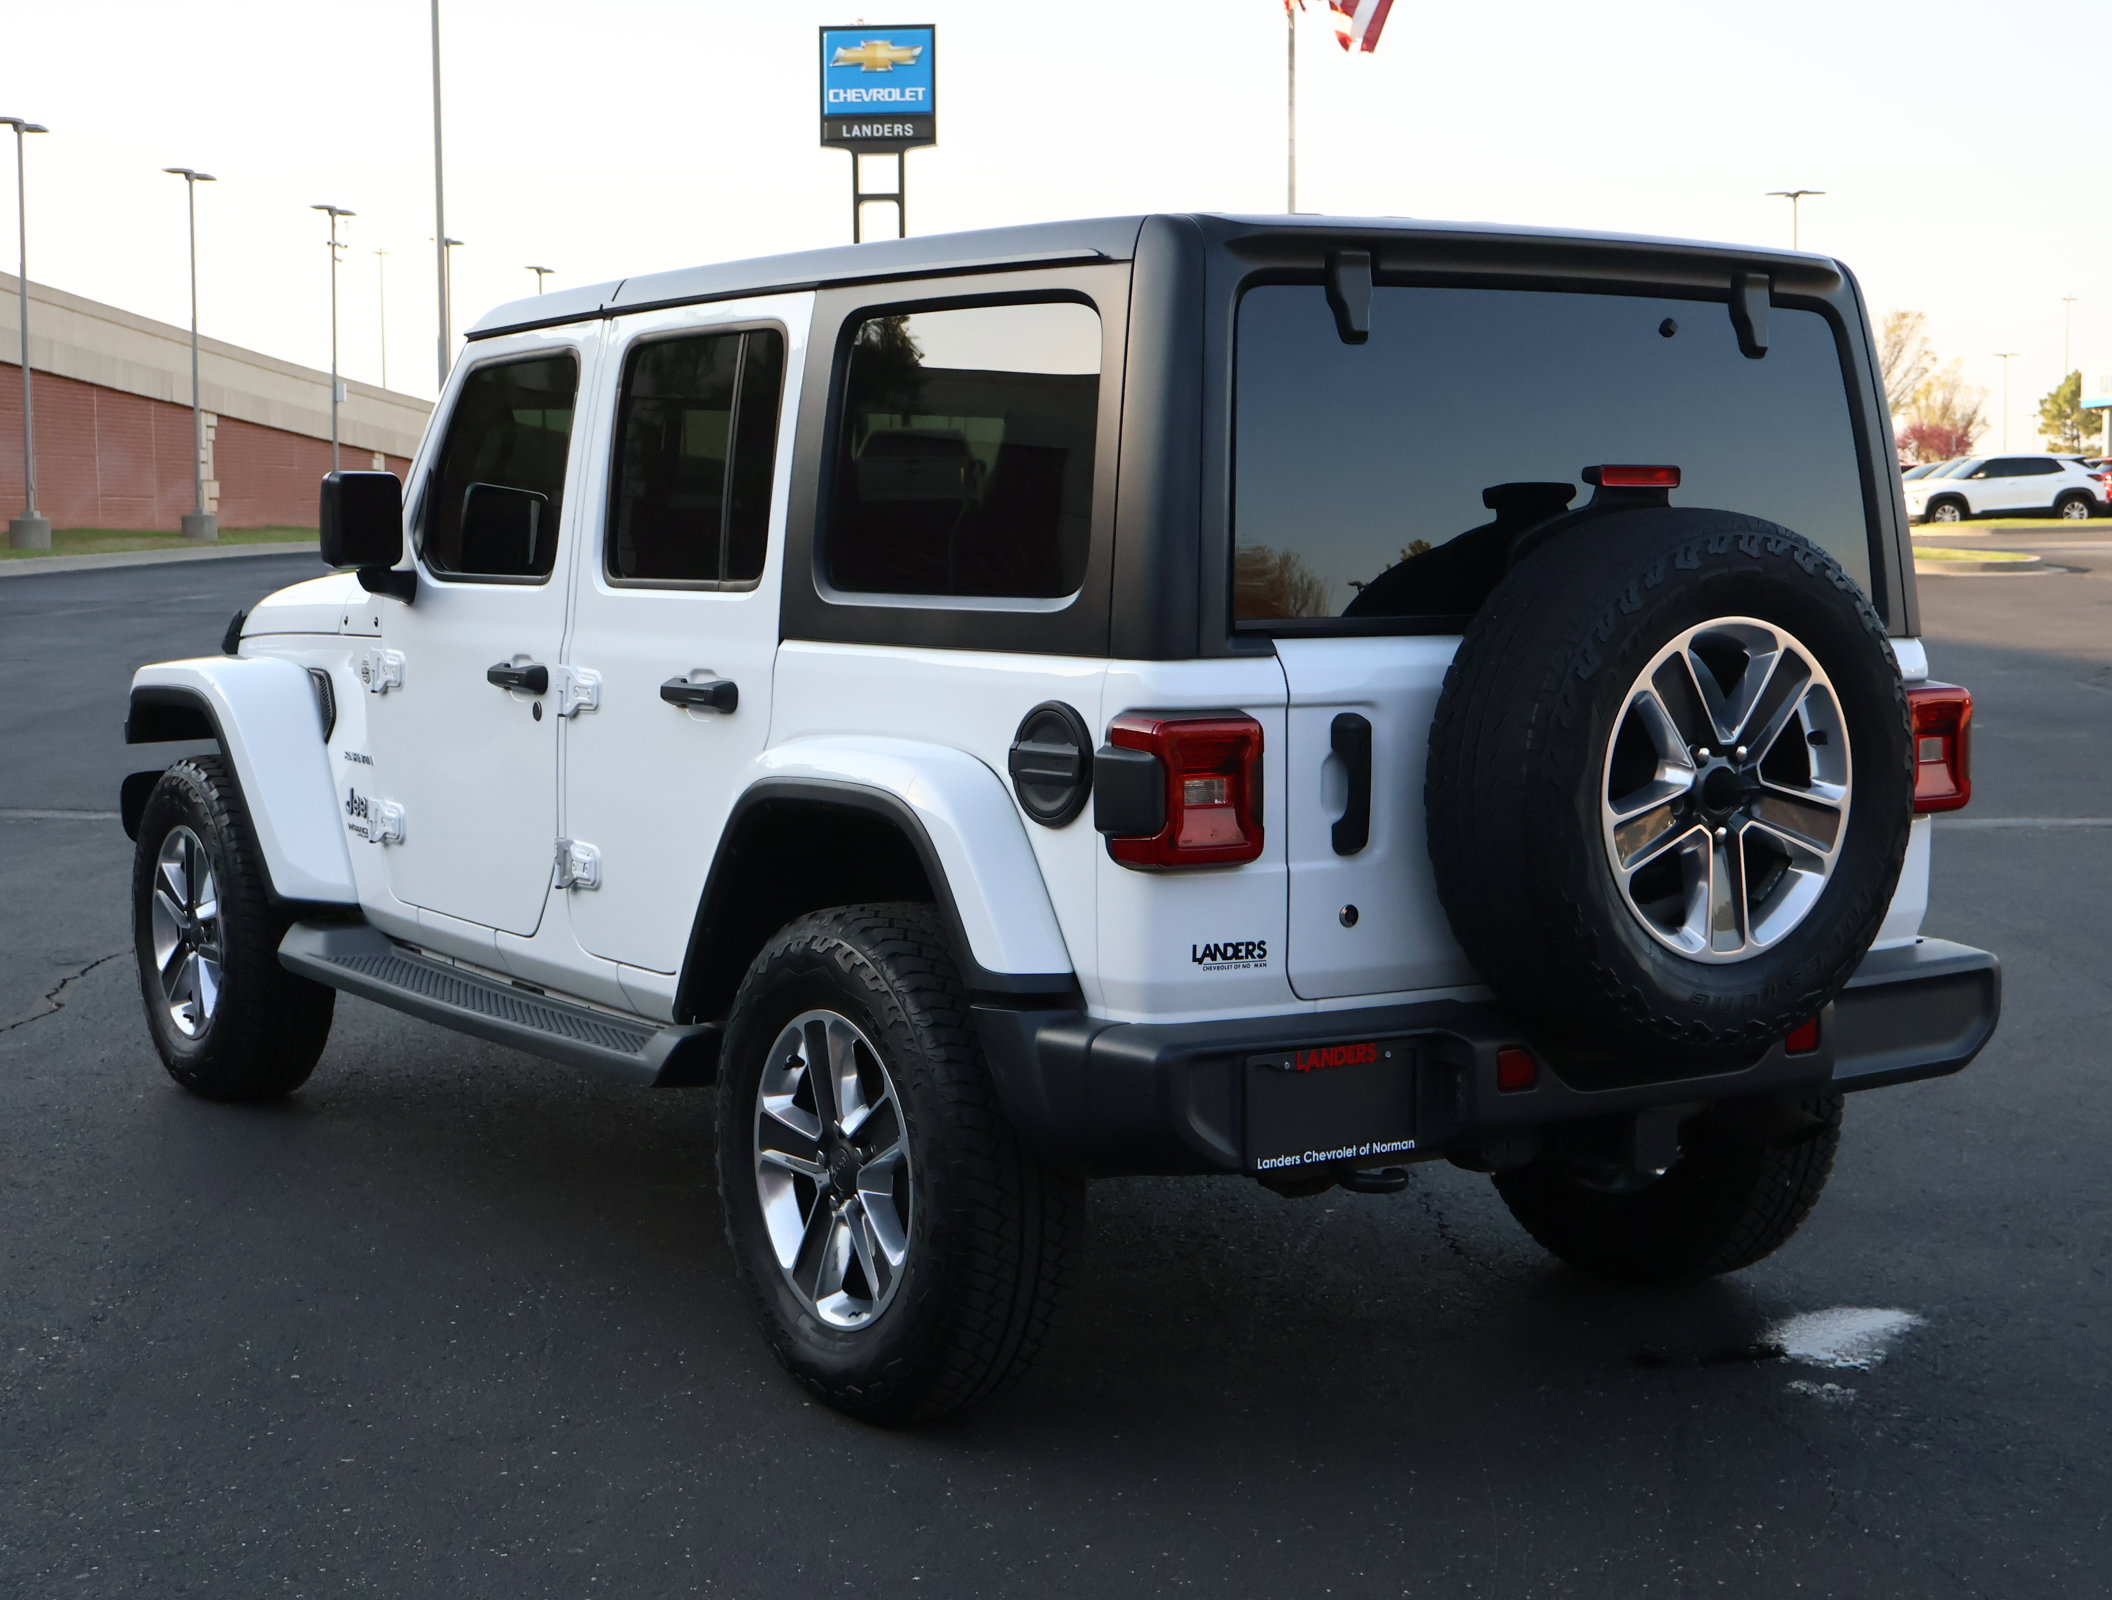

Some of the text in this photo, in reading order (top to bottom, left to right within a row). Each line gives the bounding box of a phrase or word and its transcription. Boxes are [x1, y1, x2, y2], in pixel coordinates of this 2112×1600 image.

[828, 87, 926, 103] CHEVROLET
[842, 123, 914, 138] LANDERS
[346, 787, 369, 819] Jee
[1192, 940, 1267, 965] LANDERS
[1296, 1042, 1378, 1073] LANDERS
[1257, 1139, 1415, 1170] Landers Chevrolet of Norman
